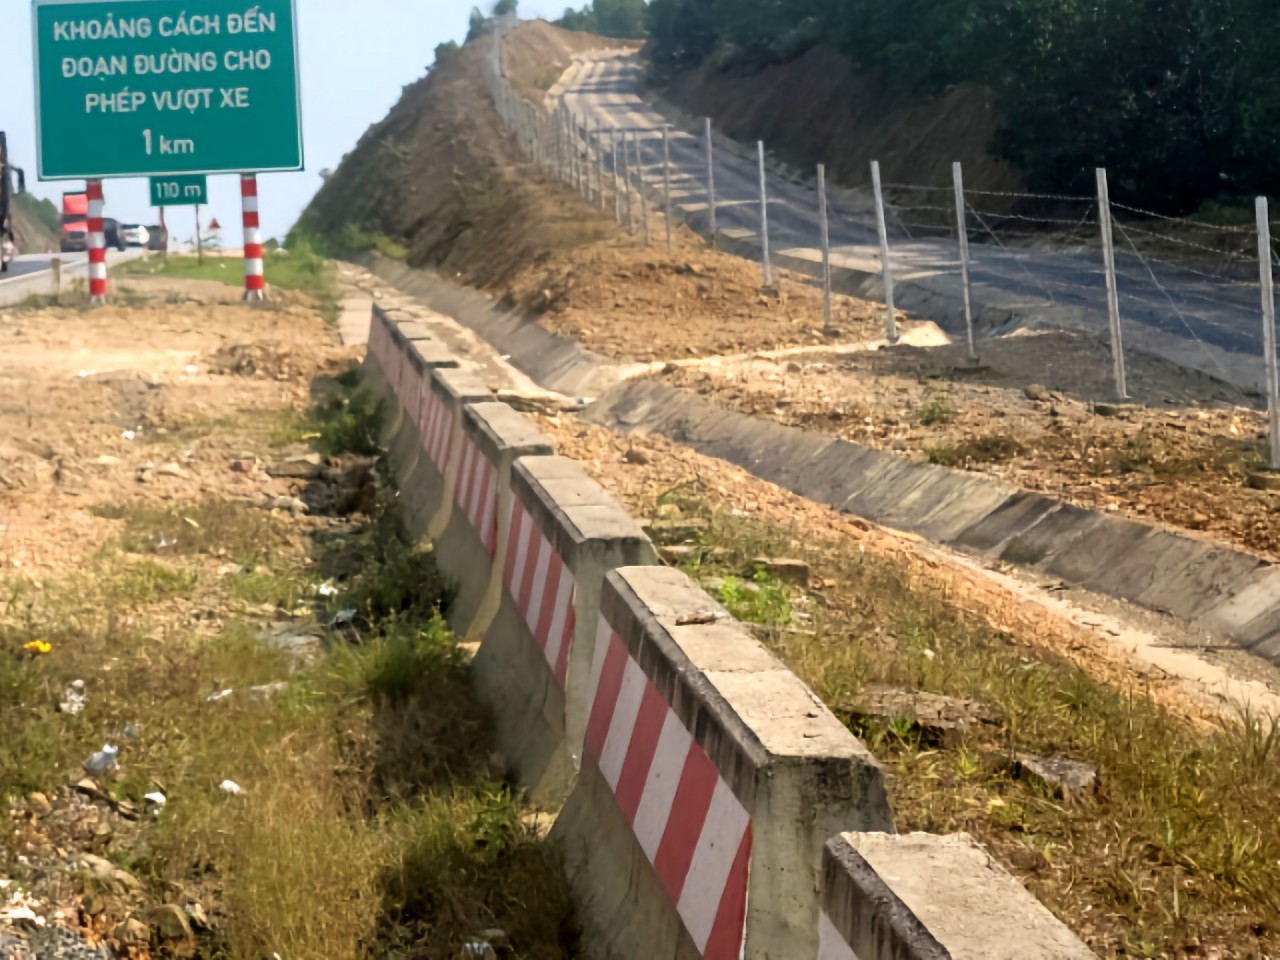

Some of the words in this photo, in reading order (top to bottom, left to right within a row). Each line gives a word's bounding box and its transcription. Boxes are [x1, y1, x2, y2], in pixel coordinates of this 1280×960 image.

[53, 12, 152, 41] KHOẢNG
[158, 10, 221, 37] CÁCH
[227, 5, 276, 35] ĐẾN
[61, 55, 128, 82] ĐOẠN
[134, 48, 218, 75] ĐƯỜNG
[223, 49, 272, 71] CHO
[85, 86, 147, 114] PHÉP
[151, 88, 214, 115] VƯỢT
[219, 87, 250, 108] XE
[142, 128, 153, 156] 1
[159, 135, 195, 155] km
[155, 182, 180, 199] 110
[184, 184, 202, 198] m
